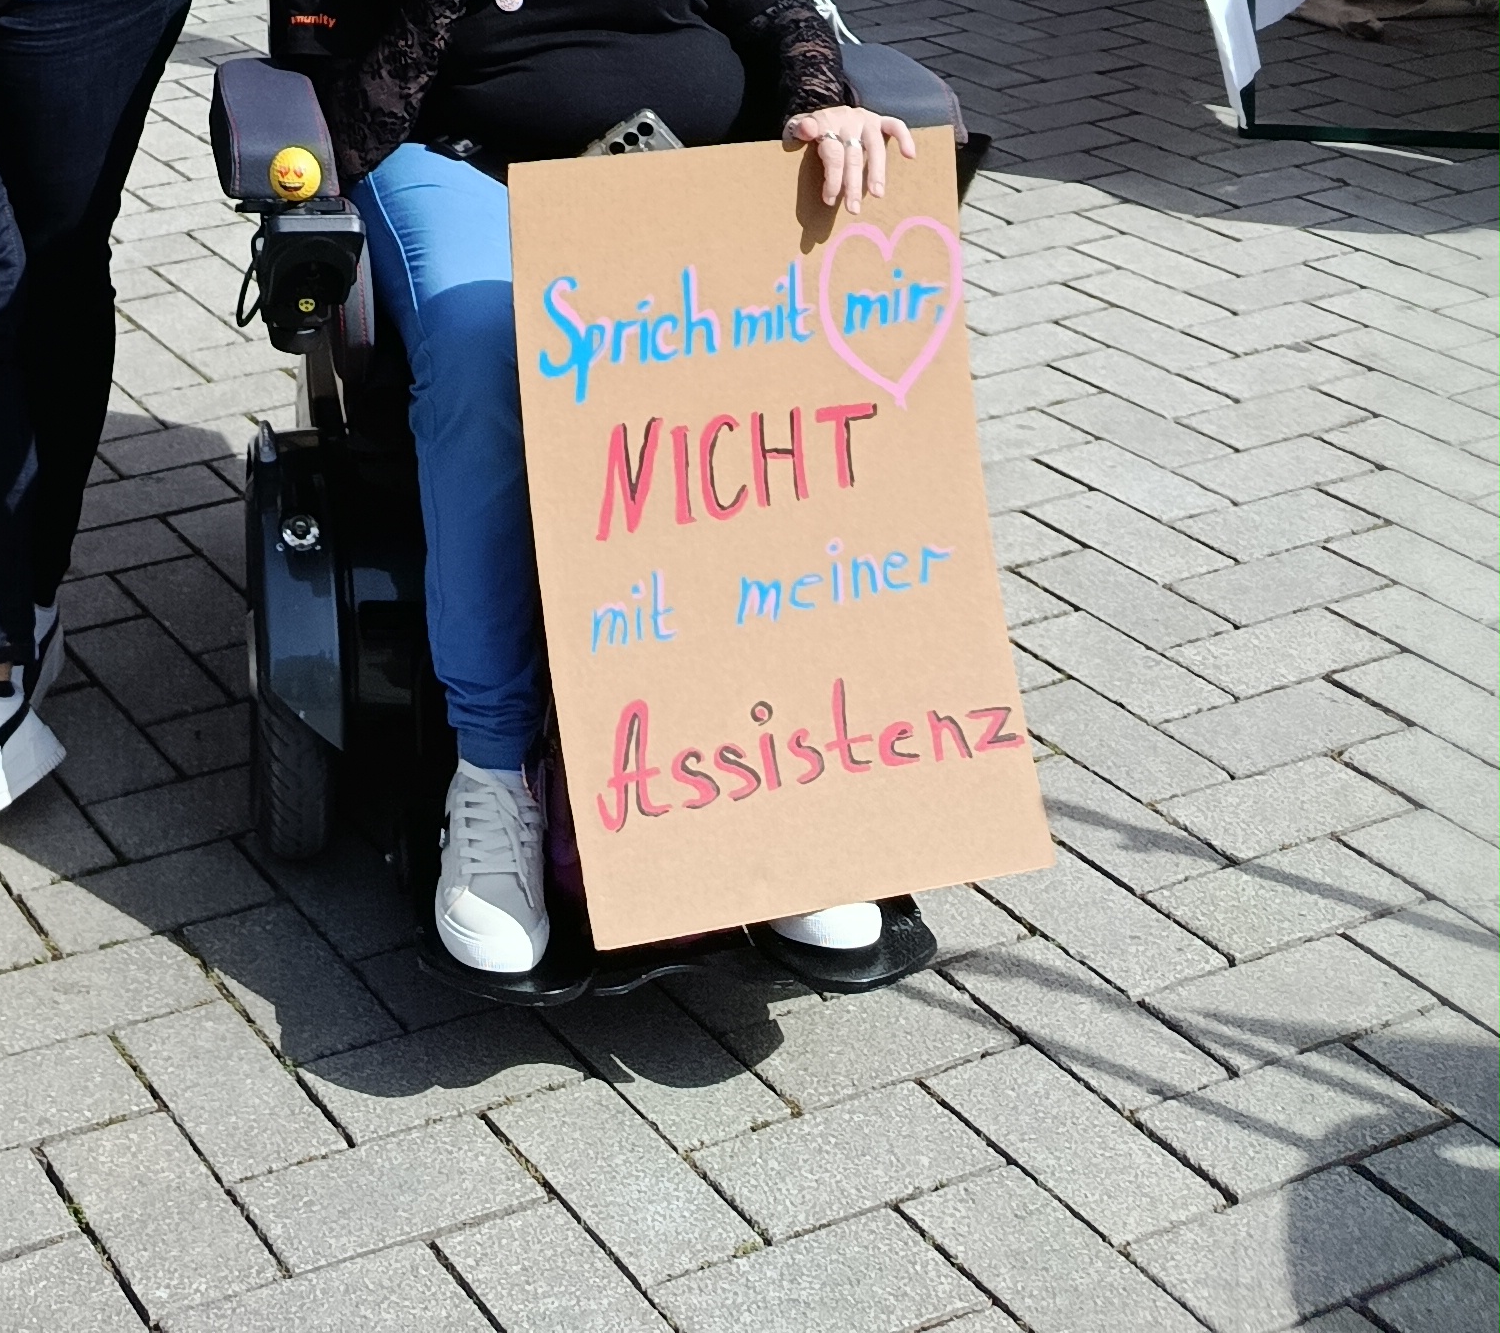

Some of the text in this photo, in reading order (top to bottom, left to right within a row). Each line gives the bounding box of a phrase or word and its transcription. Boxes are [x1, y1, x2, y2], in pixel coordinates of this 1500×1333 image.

[538, 265, 722, 404] Sprich
[733, 256, 819, 346] mit
[596, 403, 878, 542] NICHT
[591, 537, 955, 654] mit meiner
[597, 677, 1026, 833] Assistenz
